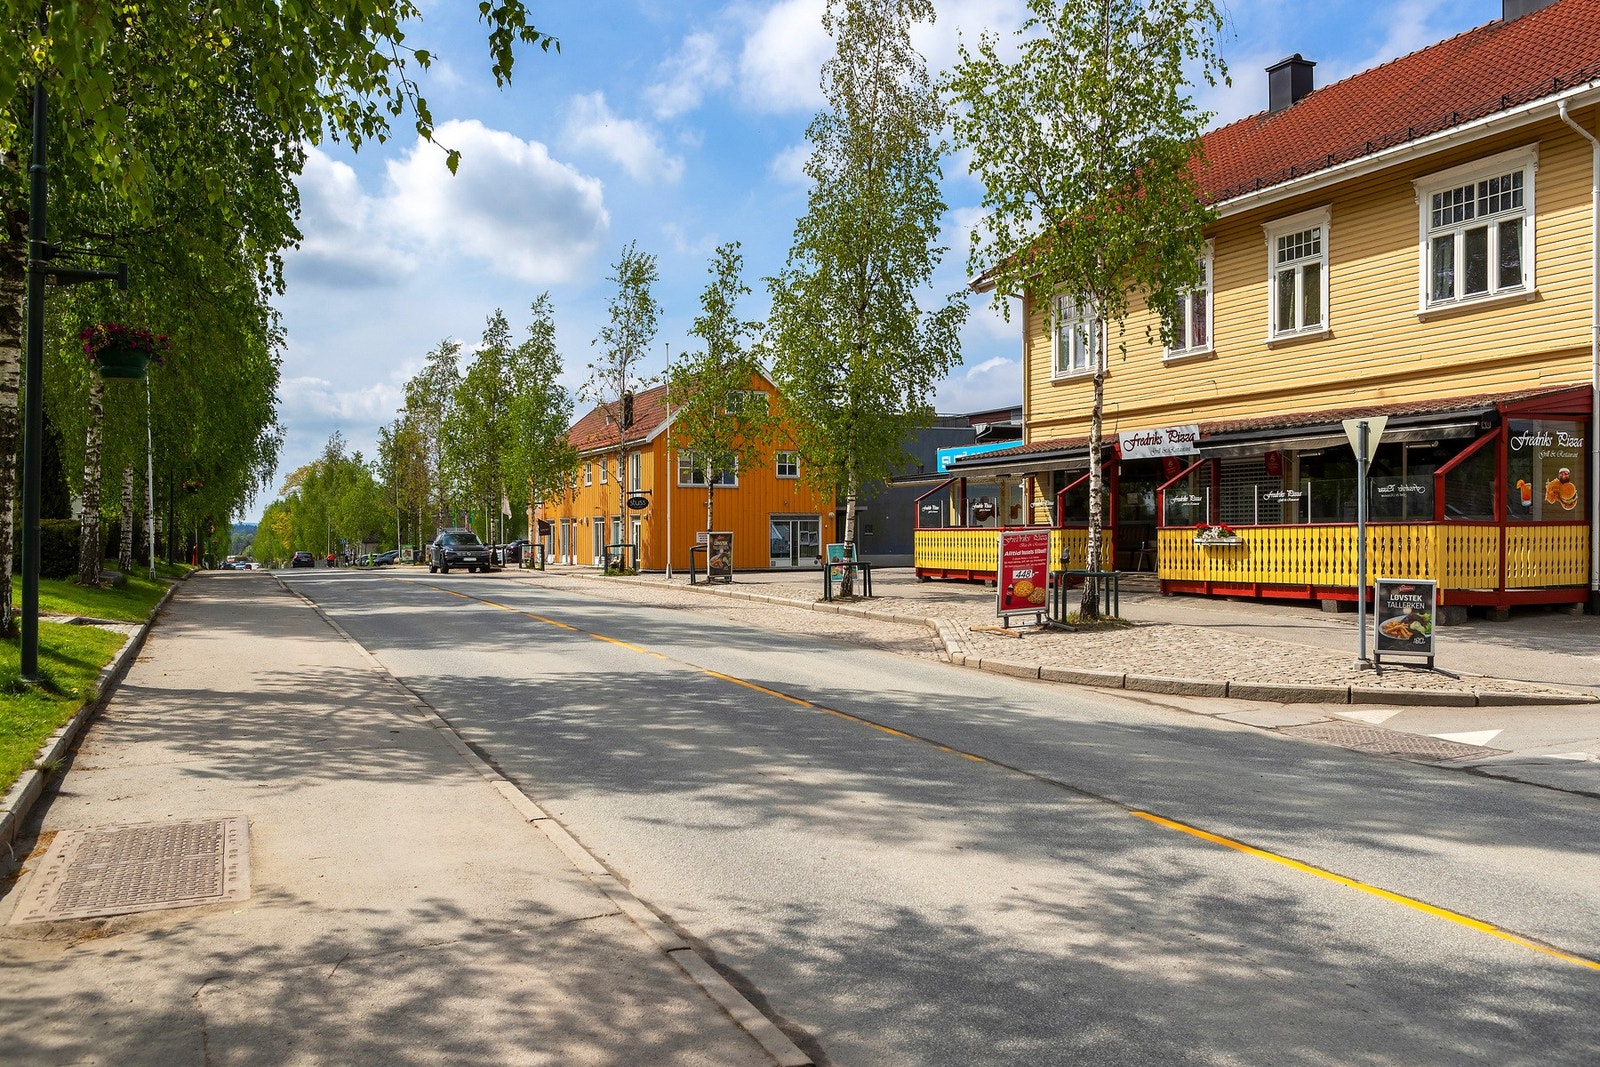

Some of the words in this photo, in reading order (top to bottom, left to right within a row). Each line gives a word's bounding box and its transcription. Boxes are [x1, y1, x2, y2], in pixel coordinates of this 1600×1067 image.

[1123, 432, 1163, 452] Fredriks
[1166, 429, 1195, 444] Pizza
[1510, 430, 1553, 451] Fredriks
[1556, 430, 1584, 447] Pizza
[1387, 601, 1425, 609] TALLERKEN
